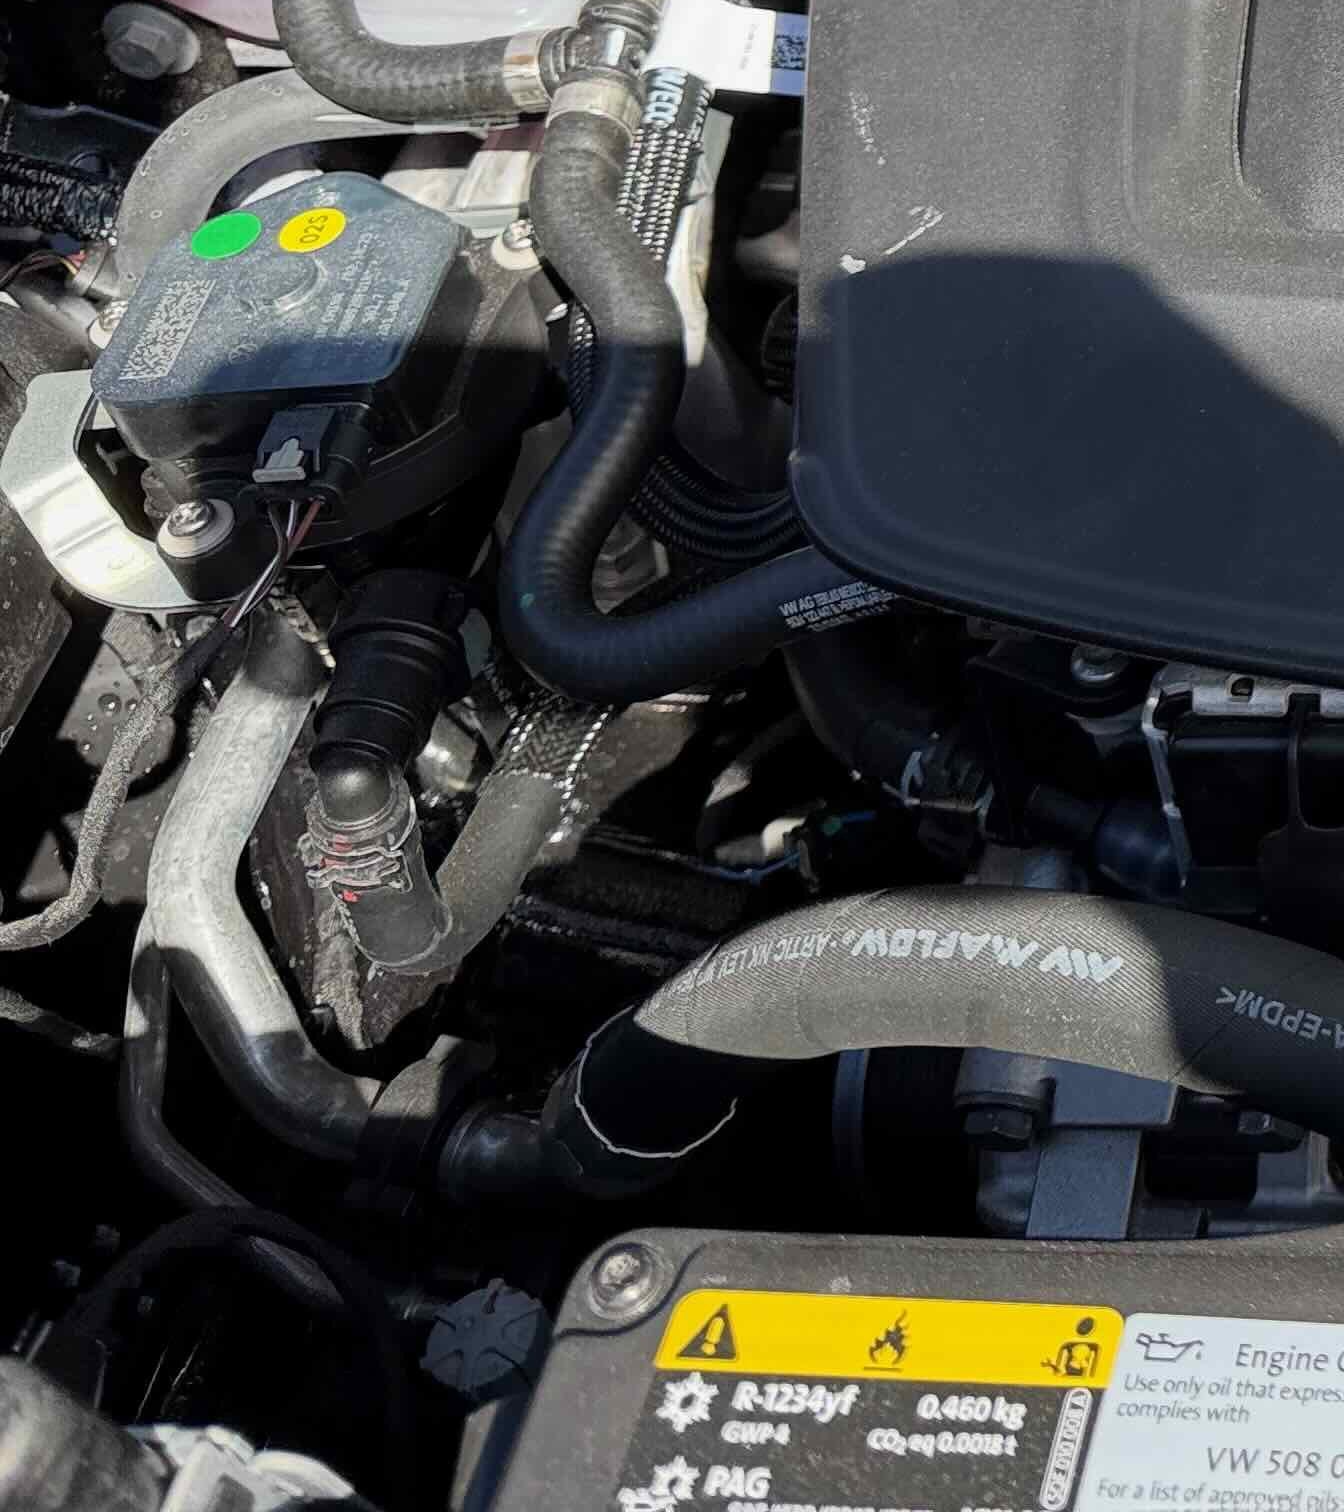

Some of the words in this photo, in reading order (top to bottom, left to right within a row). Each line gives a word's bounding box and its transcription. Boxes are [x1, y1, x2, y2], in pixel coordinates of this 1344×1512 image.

[1235, 1343, 1329, 1377] Engine
[731, 1380, 861, 1425] R-1234yf
[1124, 1373, 1160, 1393] Use
[1163, 1375, 1205, 1401] only
[1207, 1376, 1232, 1394] oil
[1236, 1379, 1275, 1401] that
[1116, 1399, 1202, 1424] complies
[1207, 1404, 1250, 1424] with
[1206, 1446, 1260, 1474] VW
[1265, 1448, 1322, 1478] 508
[703, 1464, 773, 1499] PAG
[1096, 1477, 1128, 1499] For
[1149, 1479, 1180, 1502] list
[1183, 1481, 1207, 1503] of
